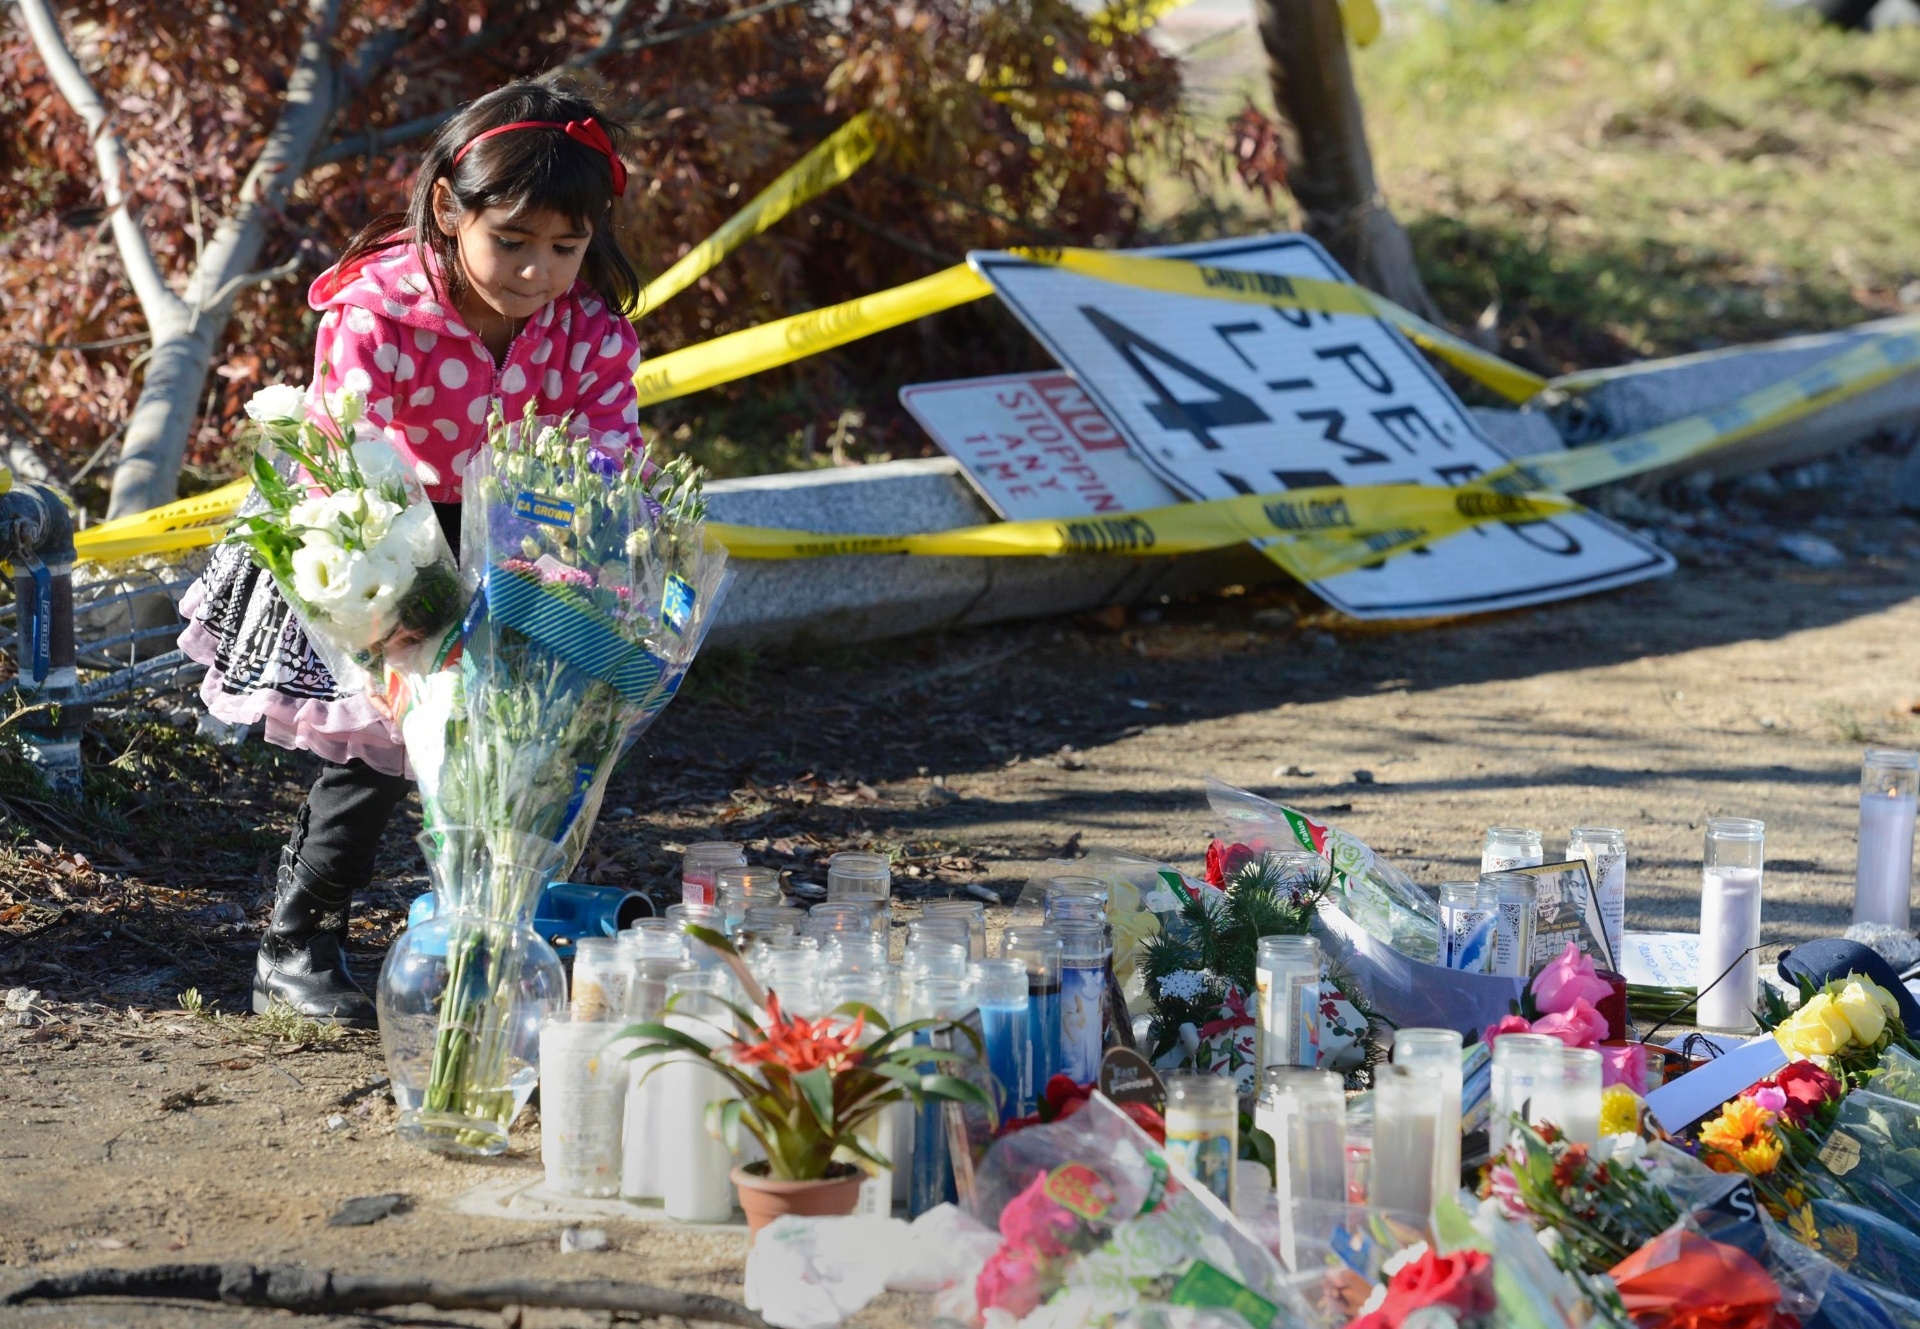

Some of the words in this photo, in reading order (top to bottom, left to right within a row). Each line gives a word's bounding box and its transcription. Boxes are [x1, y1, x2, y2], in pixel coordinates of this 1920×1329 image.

[1044, 386, 1118, 443] NO
[1213, 322, 1415, 485] LIM
[964, 433, 1038, 500] TIME
[996, 389, 1125, 512] STOPPIN
[997, 433, 1068, 492] ANY
[517, 500, 531, 512] CA
[534, 504, 572, 522] GROWN
[441, 630, 460, 653] Value
[1297, 820, 1310, 843] Value
